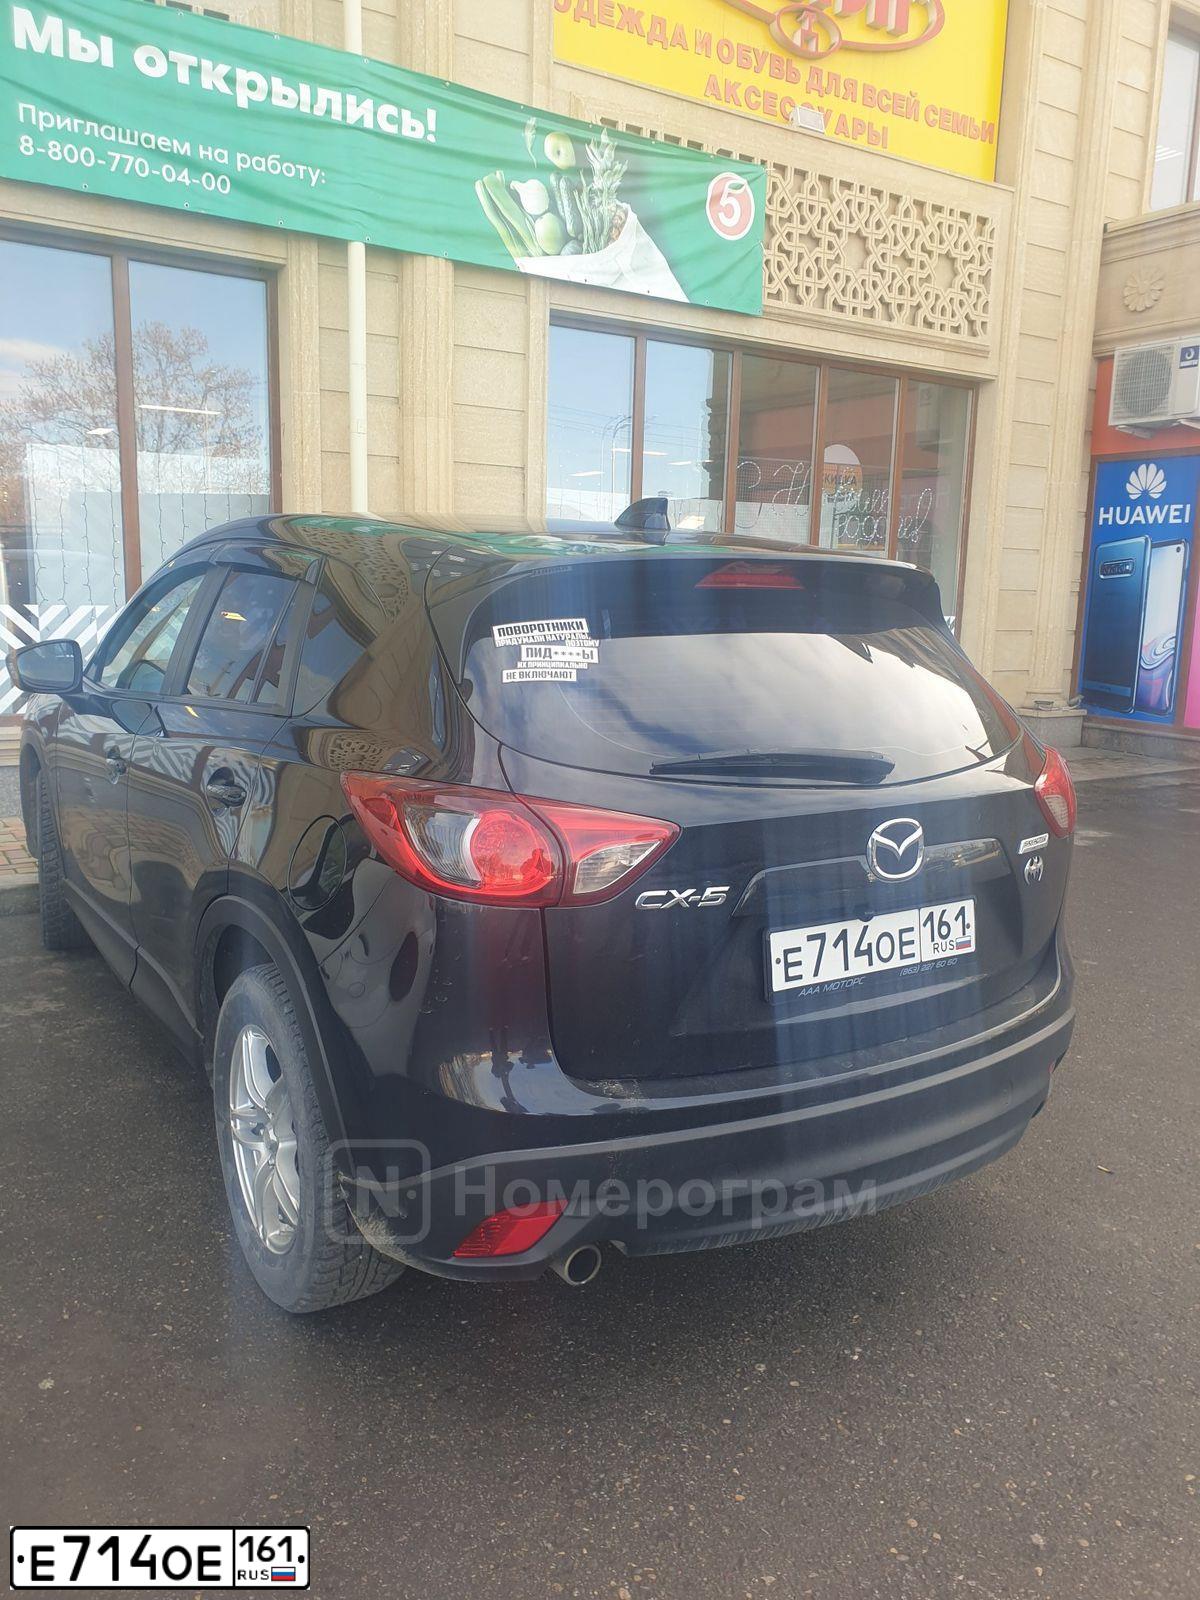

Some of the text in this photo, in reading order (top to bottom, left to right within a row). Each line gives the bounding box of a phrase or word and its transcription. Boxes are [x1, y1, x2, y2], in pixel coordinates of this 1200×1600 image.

[13, 6, 437, 144] Мы открылись!
[694, 29, 712, 58] И
[716, 39, 801, 84] ОБУВЬ
[806, 65, 858, 103] ДЛЯ
[862, 83, 920, 122] ВСЕЙ
[924, 104, 995, 145] СЕМЬИ
[704, 74, 888, 149] АКСЕСУАРЫ
[18, 102, 327, 187] Приглашаем на работу:
[19, 135, 231, 195] 8-800-770-04-00
[1098, 503, 1191, 526] HUAWEI
[497, 620, 584, 638] ПОВОРОТНИКИ
[506, 671, 573, 680] НЕ ВКЛЮЧАЮТ
[634, 886, 730, 910] CX-5
[922, 905, 967, 943] 161
[932, 939, 955, 954] RUS
[822, 976, 866, 992] МОТОРС
